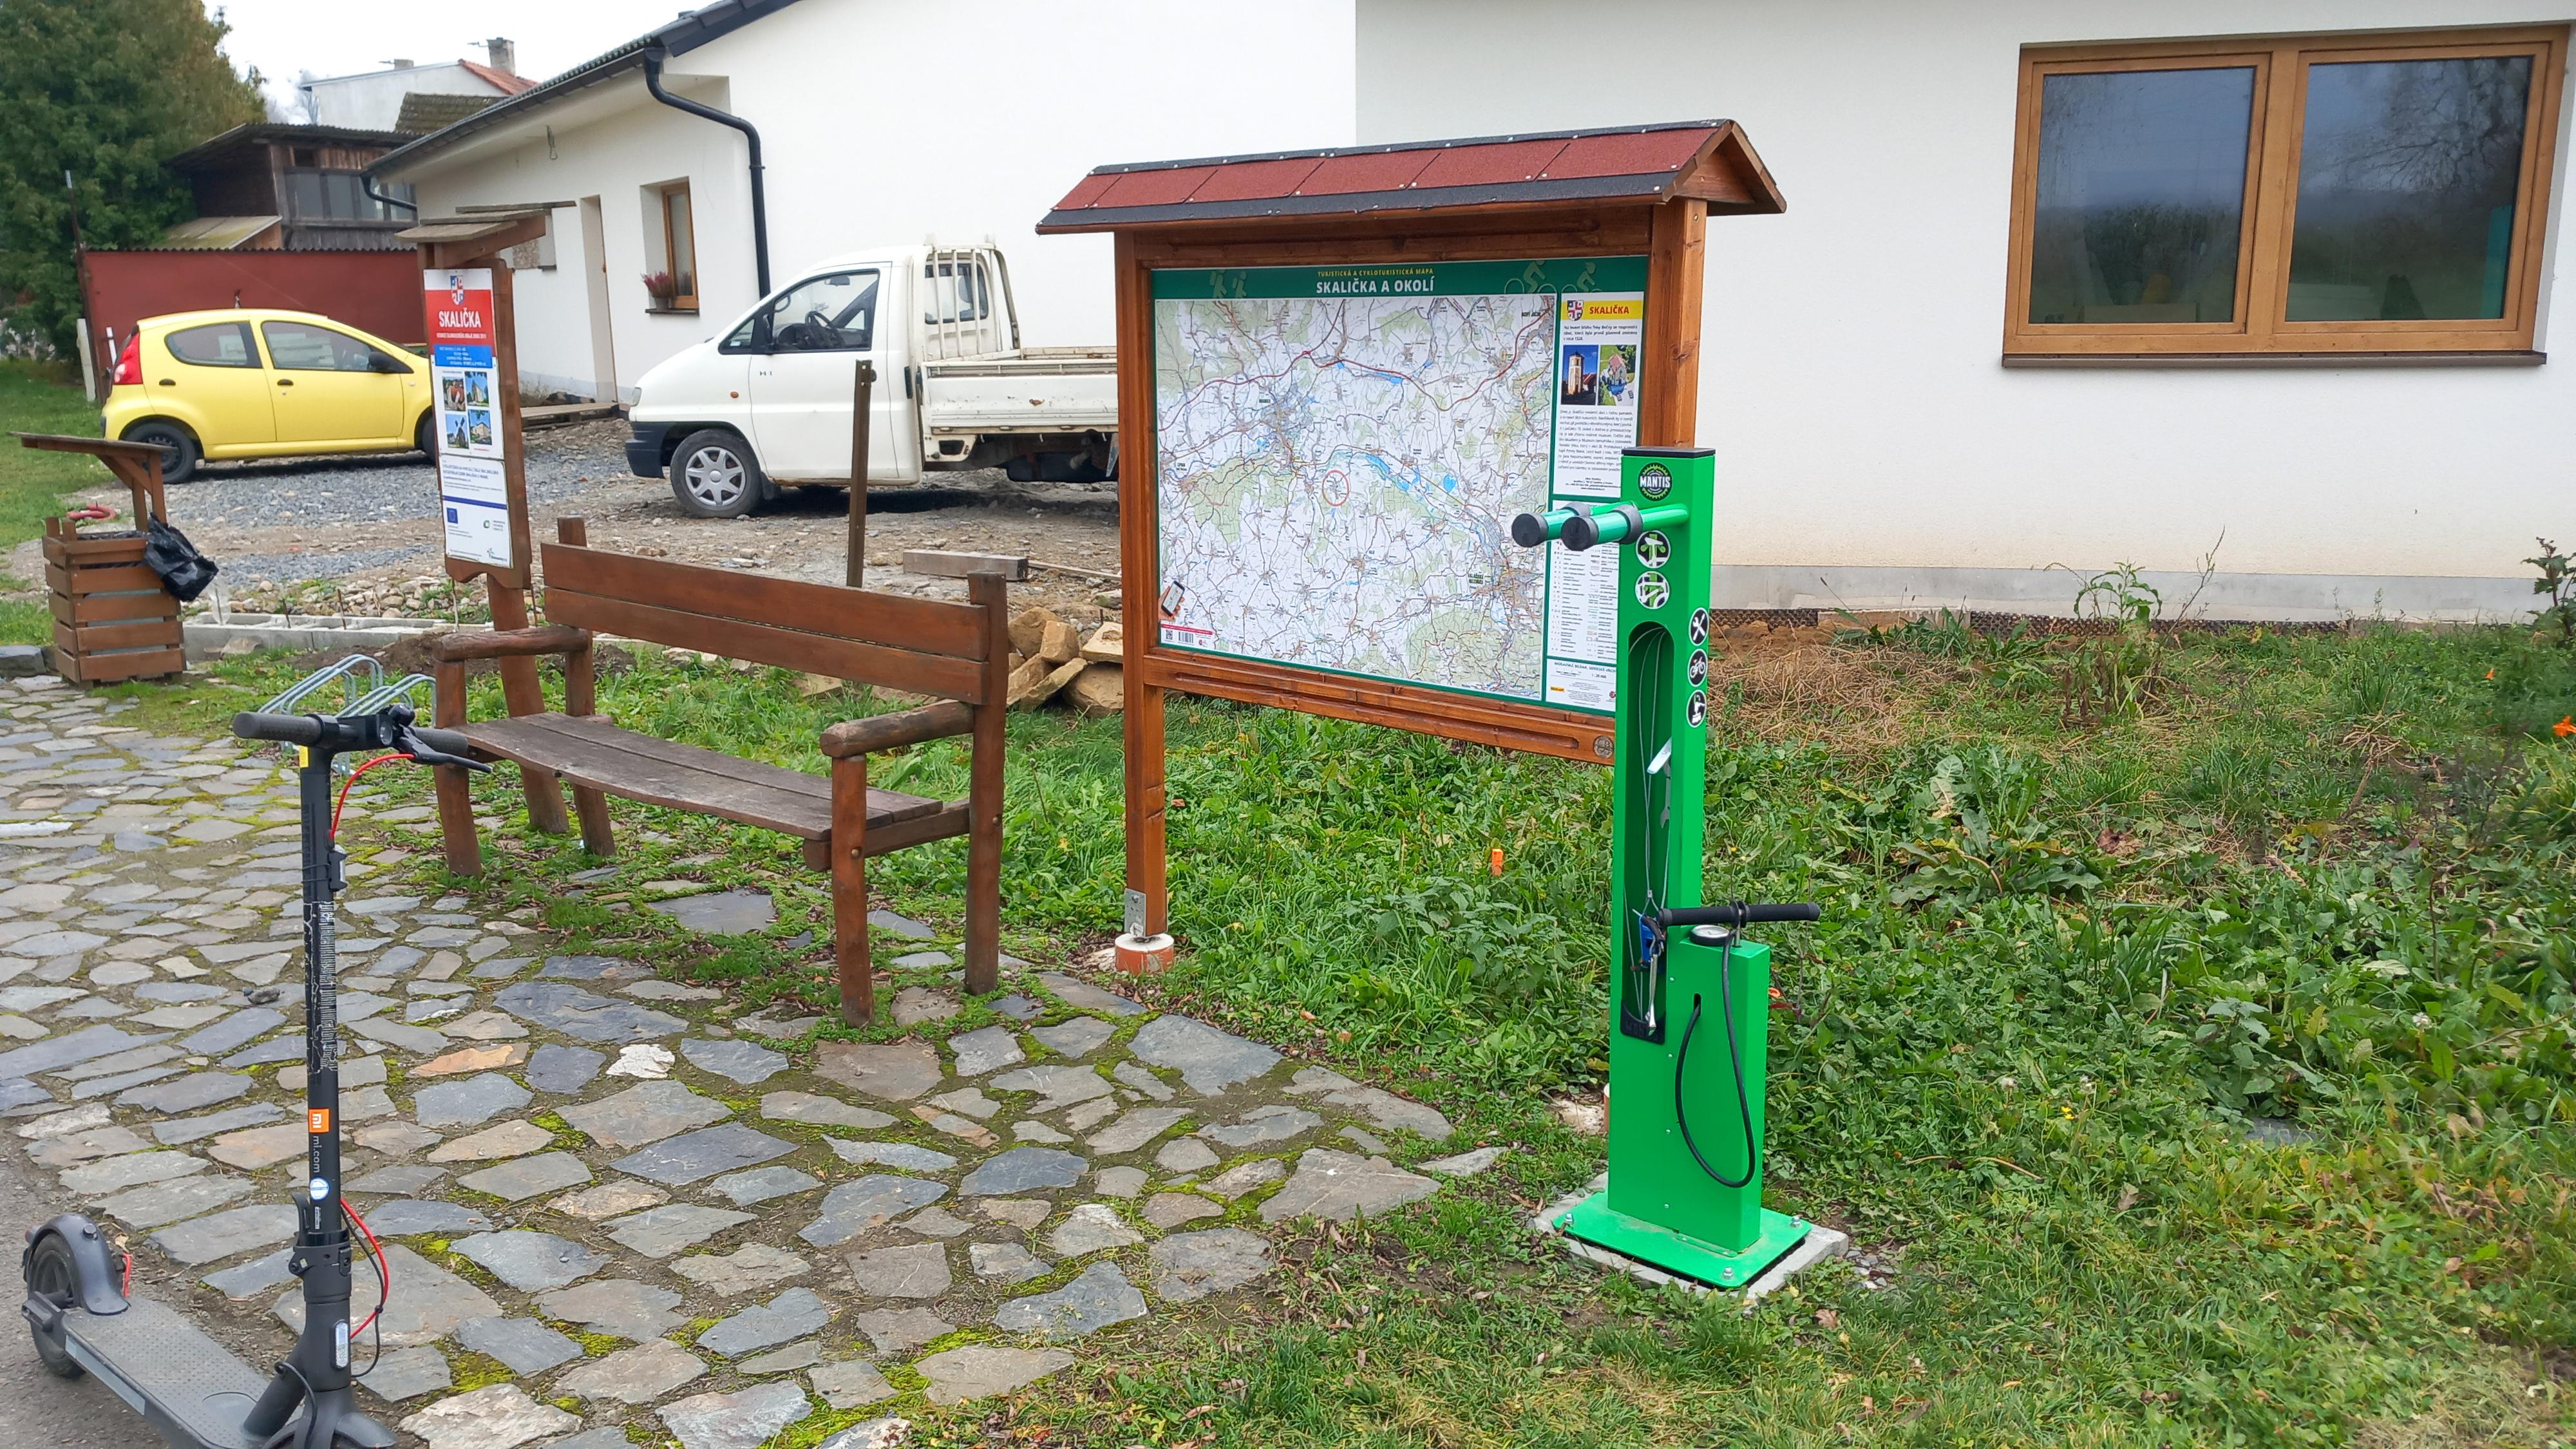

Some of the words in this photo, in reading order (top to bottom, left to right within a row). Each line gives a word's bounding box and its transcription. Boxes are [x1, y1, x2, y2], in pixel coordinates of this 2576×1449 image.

[1316, 278, 1377, 294] SKALIČKA
[1381, 280, 1390, 293] A
[1394, 276, 1435, 292] OKOLÍ
[439, 308, 481, 327] SKALIČKA
[1589, 305, 1630, 315] SKALIČKA
[1640, 475, 1671, 488] MANTIS
[313, 1135, 322, 1173] mi.com
